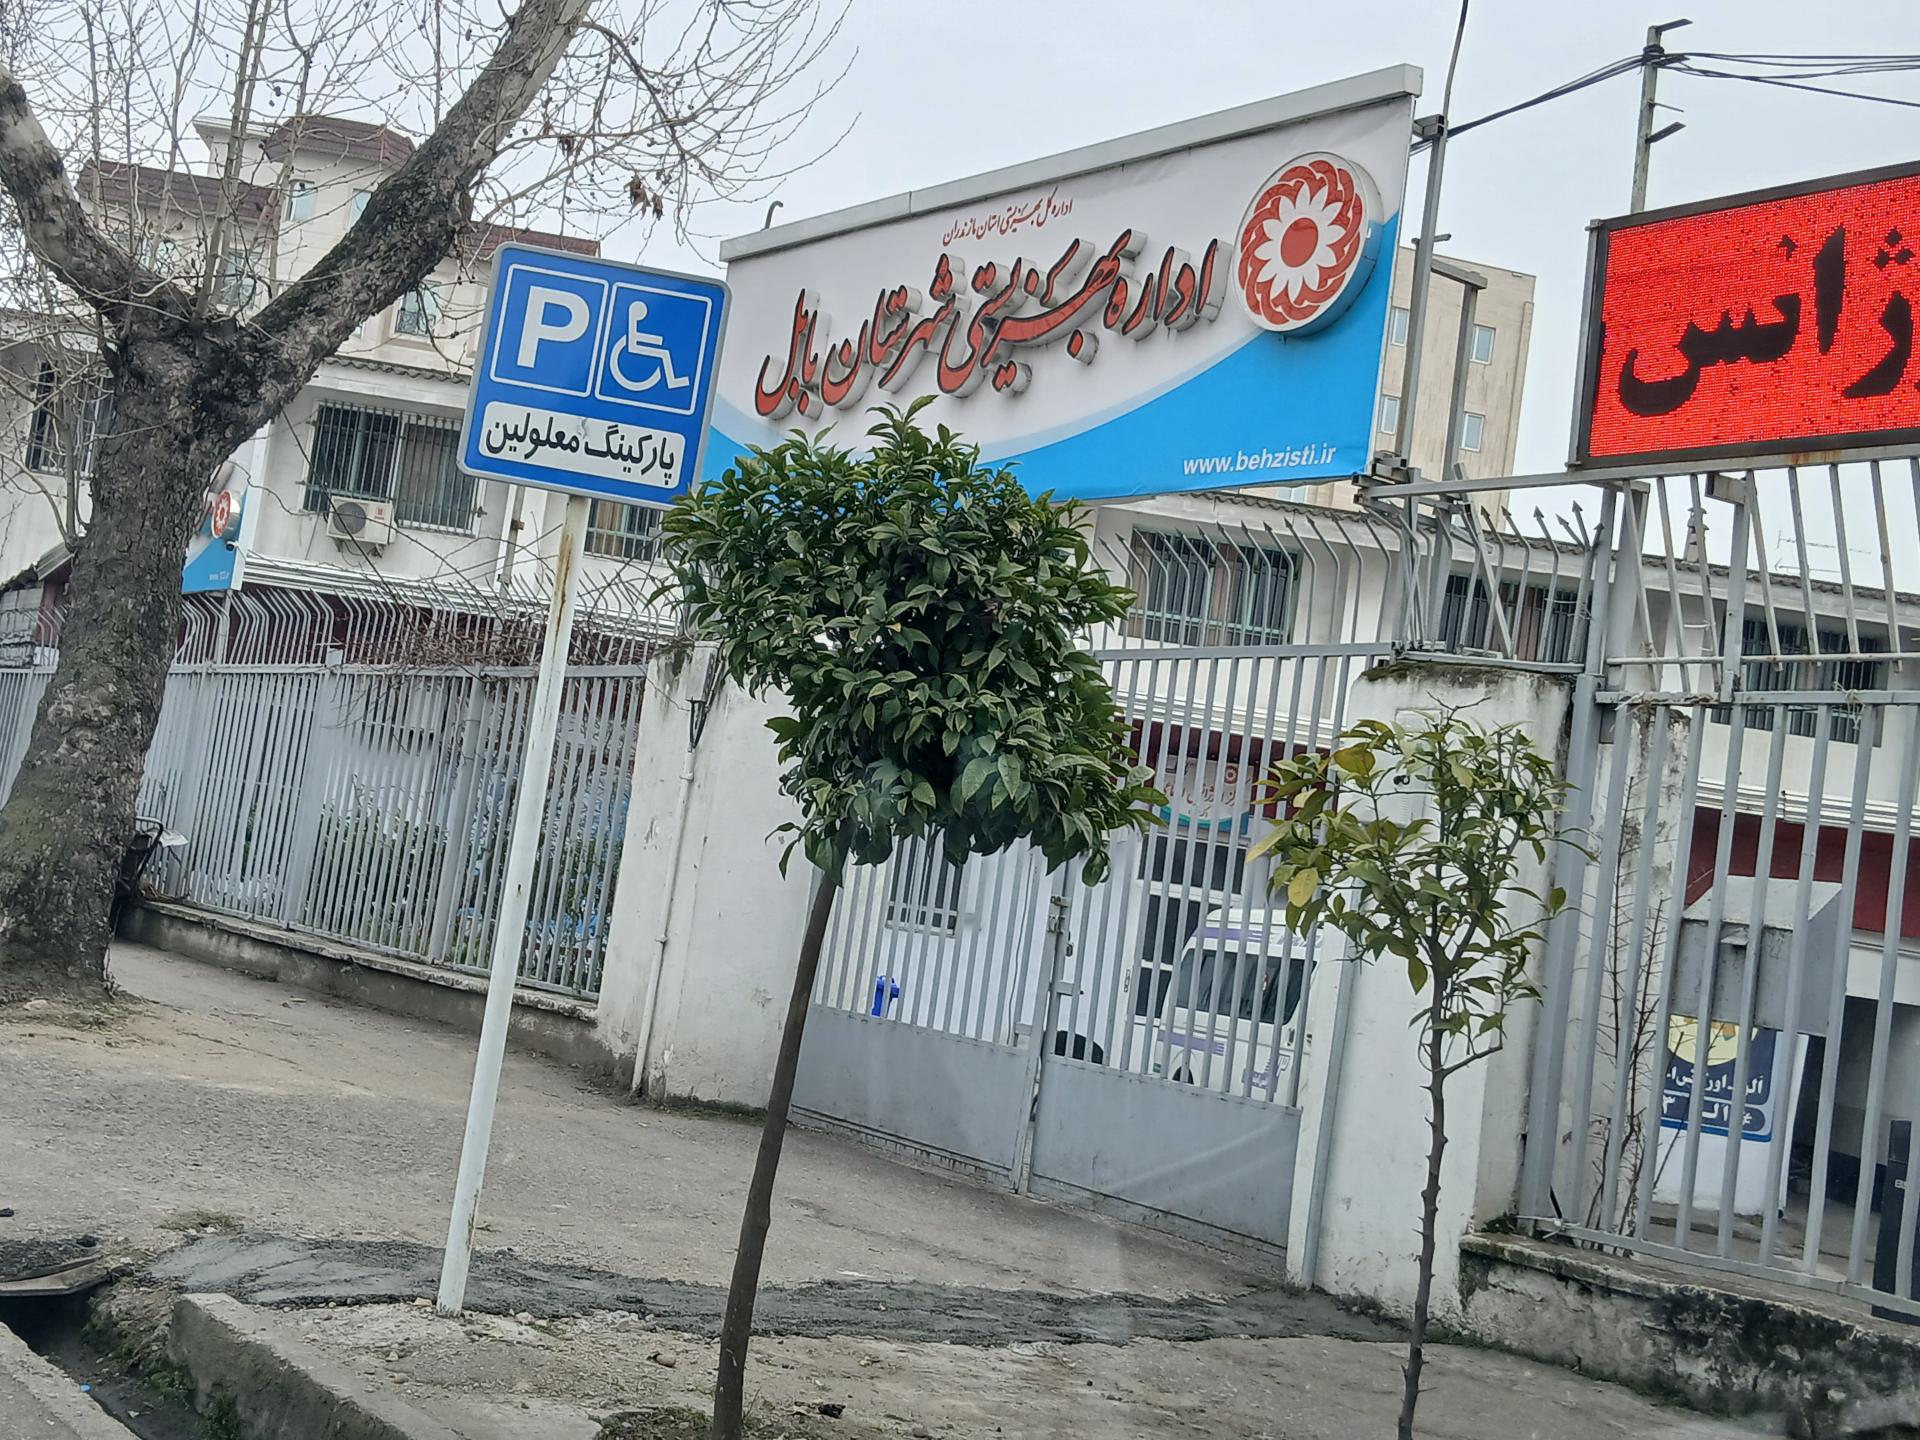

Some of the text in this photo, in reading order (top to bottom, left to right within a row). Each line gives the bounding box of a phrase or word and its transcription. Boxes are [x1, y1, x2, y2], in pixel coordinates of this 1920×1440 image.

[942, 186, 1073, 247] اداره کل بهزیستی استان مازندران
[516, 285, 590, 369] P
[755, 229, 1219, 417] اداره بهزیستی شهرستان بابل
[1618, 223, 1920, 418] ژانس
[485, 412, 675, 486] پارکینگ معلولین
[1183, 443, 1337, 475] www.behzisti.ir
